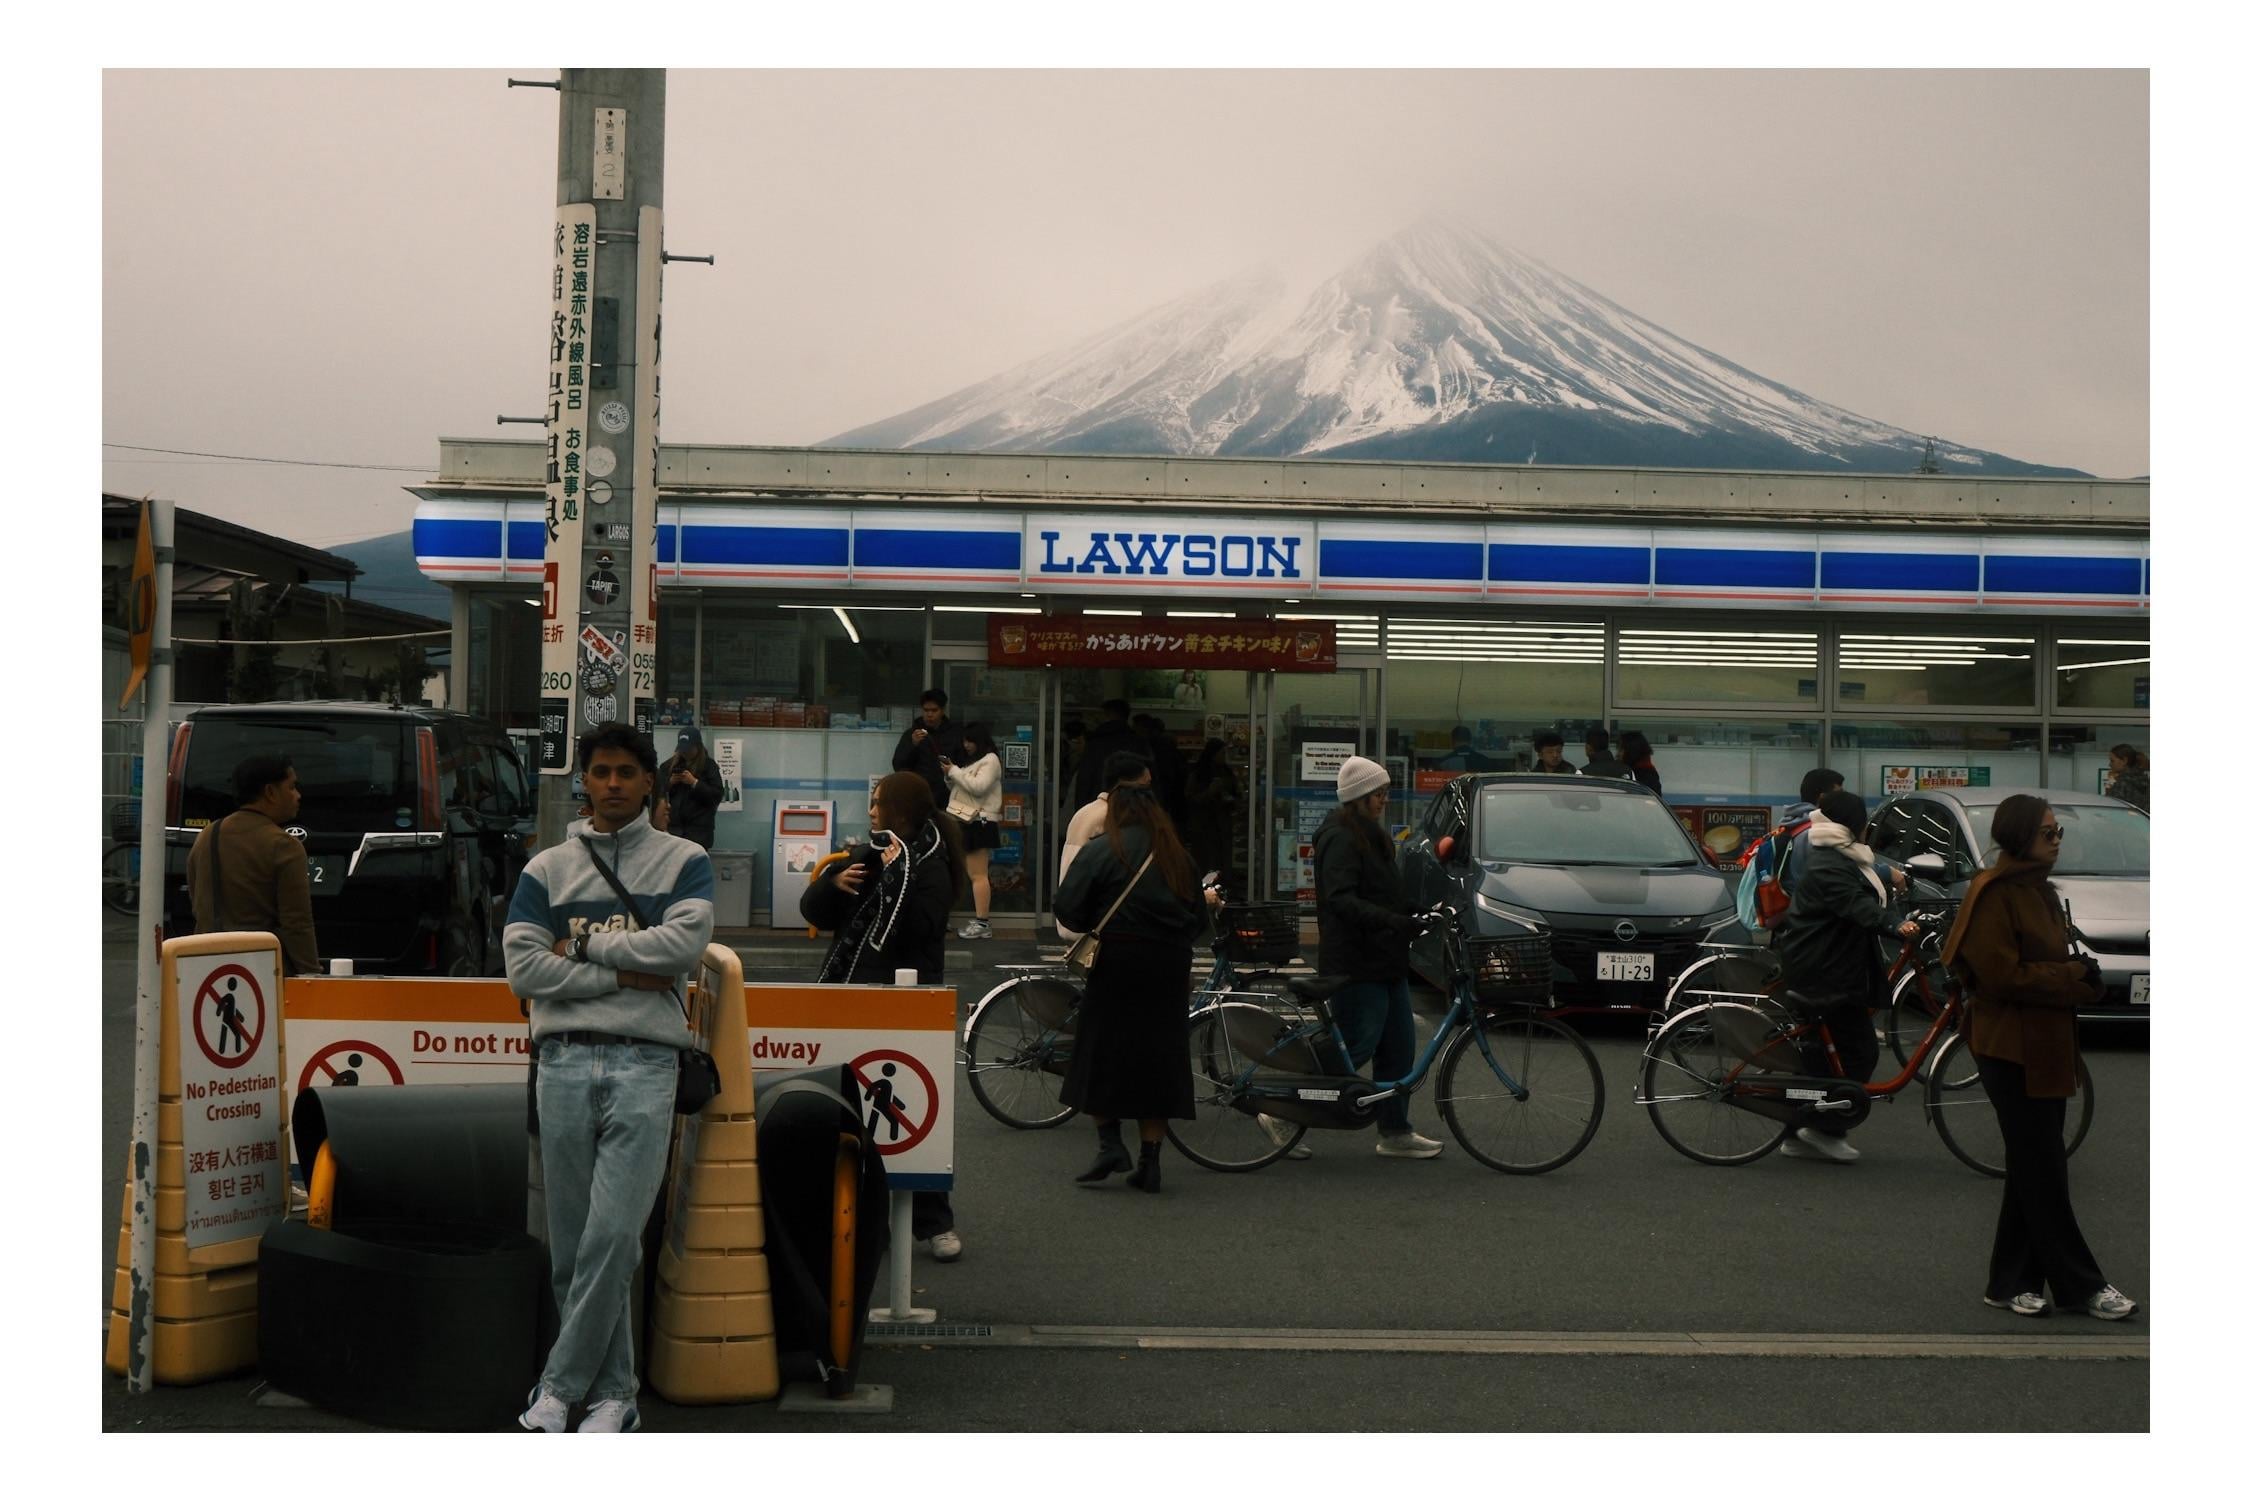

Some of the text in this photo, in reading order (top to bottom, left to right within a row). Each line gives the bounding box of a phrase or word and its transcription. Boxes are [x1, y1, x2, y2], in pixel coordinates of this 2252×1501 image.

[562, 222, 590, 522] 溶岩遠赤外線風呂 お食事処
[1040, 531, 1301, 578] LAWSON
[1612, 964, 1651, 980] 11-29
[412, 1030, 530, 1054] Do not ru
[751, 1036, 821, 1065] dway
[186, 1074, 276, 1100] No Pedestrian
[206, 1101, 261, 1122] Crossing
[189, 1140, 278, 1173] 没有人行横道
[208, 1171, 265, 1201] 횡단 금지
